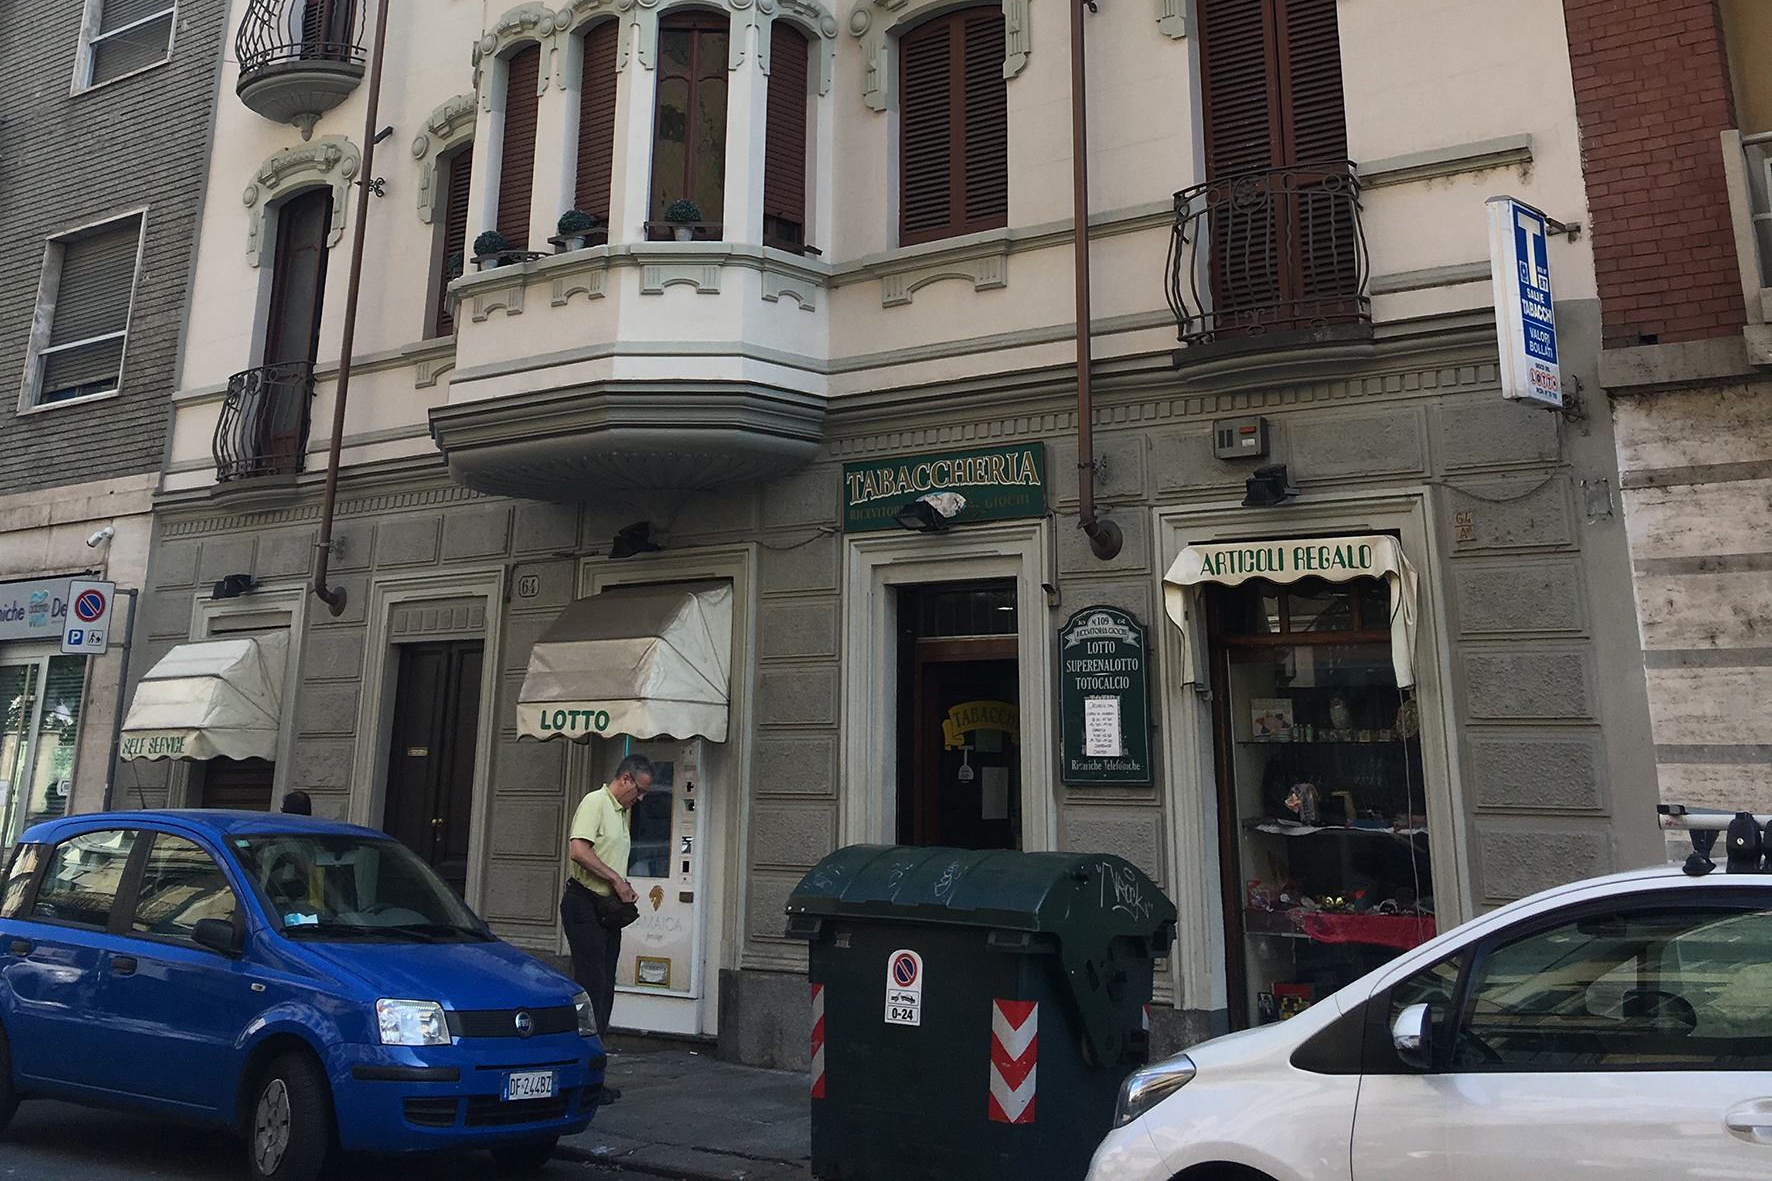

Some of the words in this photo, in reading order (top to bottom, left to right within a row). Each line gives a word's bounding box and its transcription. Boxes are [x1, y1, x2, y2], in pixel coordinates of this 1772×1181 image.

[1517, 211, 1541, 288] T
[1522, 299, 1553, 324] TABACCHI
[1529, 327, 1550, 344] VALORI
[1529, 340, 1553, 358] BOLLATI
[1530, 369, 1557, 390] LOTTO
[846, 451, 1041, 506] TABACCHERIA
[850, 505, 904, 520] RICEVITOR
[985, 493, 1030, 509] GIOCHI
[1200, 547, 1284, 576] ARTICOLI
[1293, 544, 1372, 571] REGALO
[521, 578, 536, 594] 64
[70, 631, 81, 644] P
[1087, 640, 1116, 655] LOTTO
[1066, 657, 1139, 673] SUPERENALOTTO
[1075, 676, 1130, 690] TOTOCALCIO
[540, 709, 610, 732] LOTTO
[953, 706, 1019, 729] TABACCH
[122, 737, 146, 755] SELF
[148, 735, 187, 755] SERVICE
[629, 916, 682, 932] AMAICA
[892, 1007, 913, 1021] 0-24
